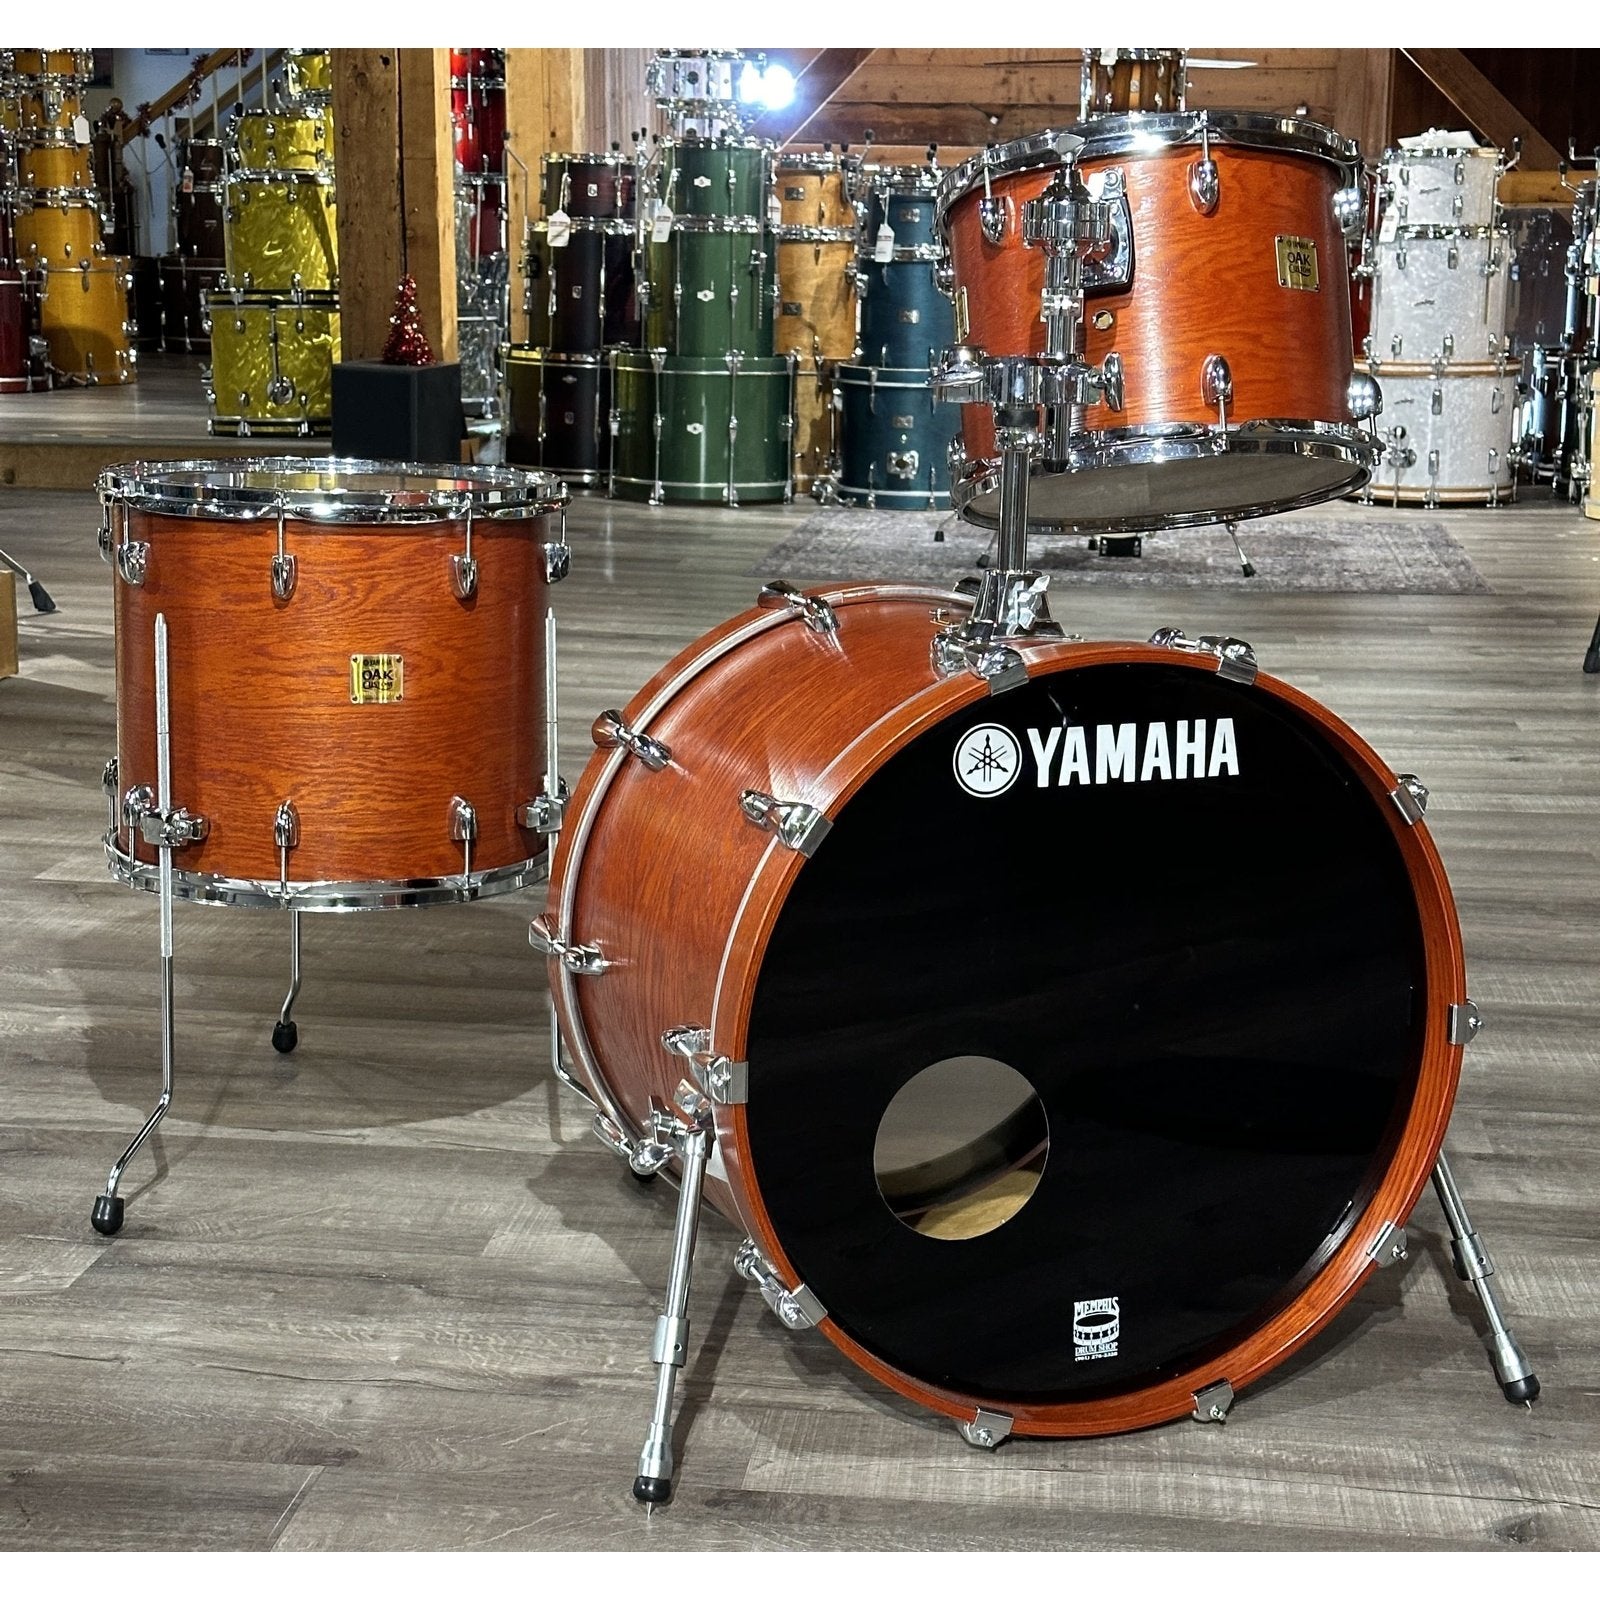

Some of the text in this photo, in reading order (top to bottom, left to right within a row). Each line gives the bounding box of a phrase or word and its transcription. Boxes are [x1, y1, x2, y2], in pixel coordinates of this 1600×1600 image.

[1287, 252, 1311, 267] OAK
[362, 669, 394, 681] OAK
[1026, 717, 1240, 788] YAMAHA
[1073, 1296, 1120, 1318] MEMPHIS
[1074, 1341, 1119, 1357] DRUM SHOP
